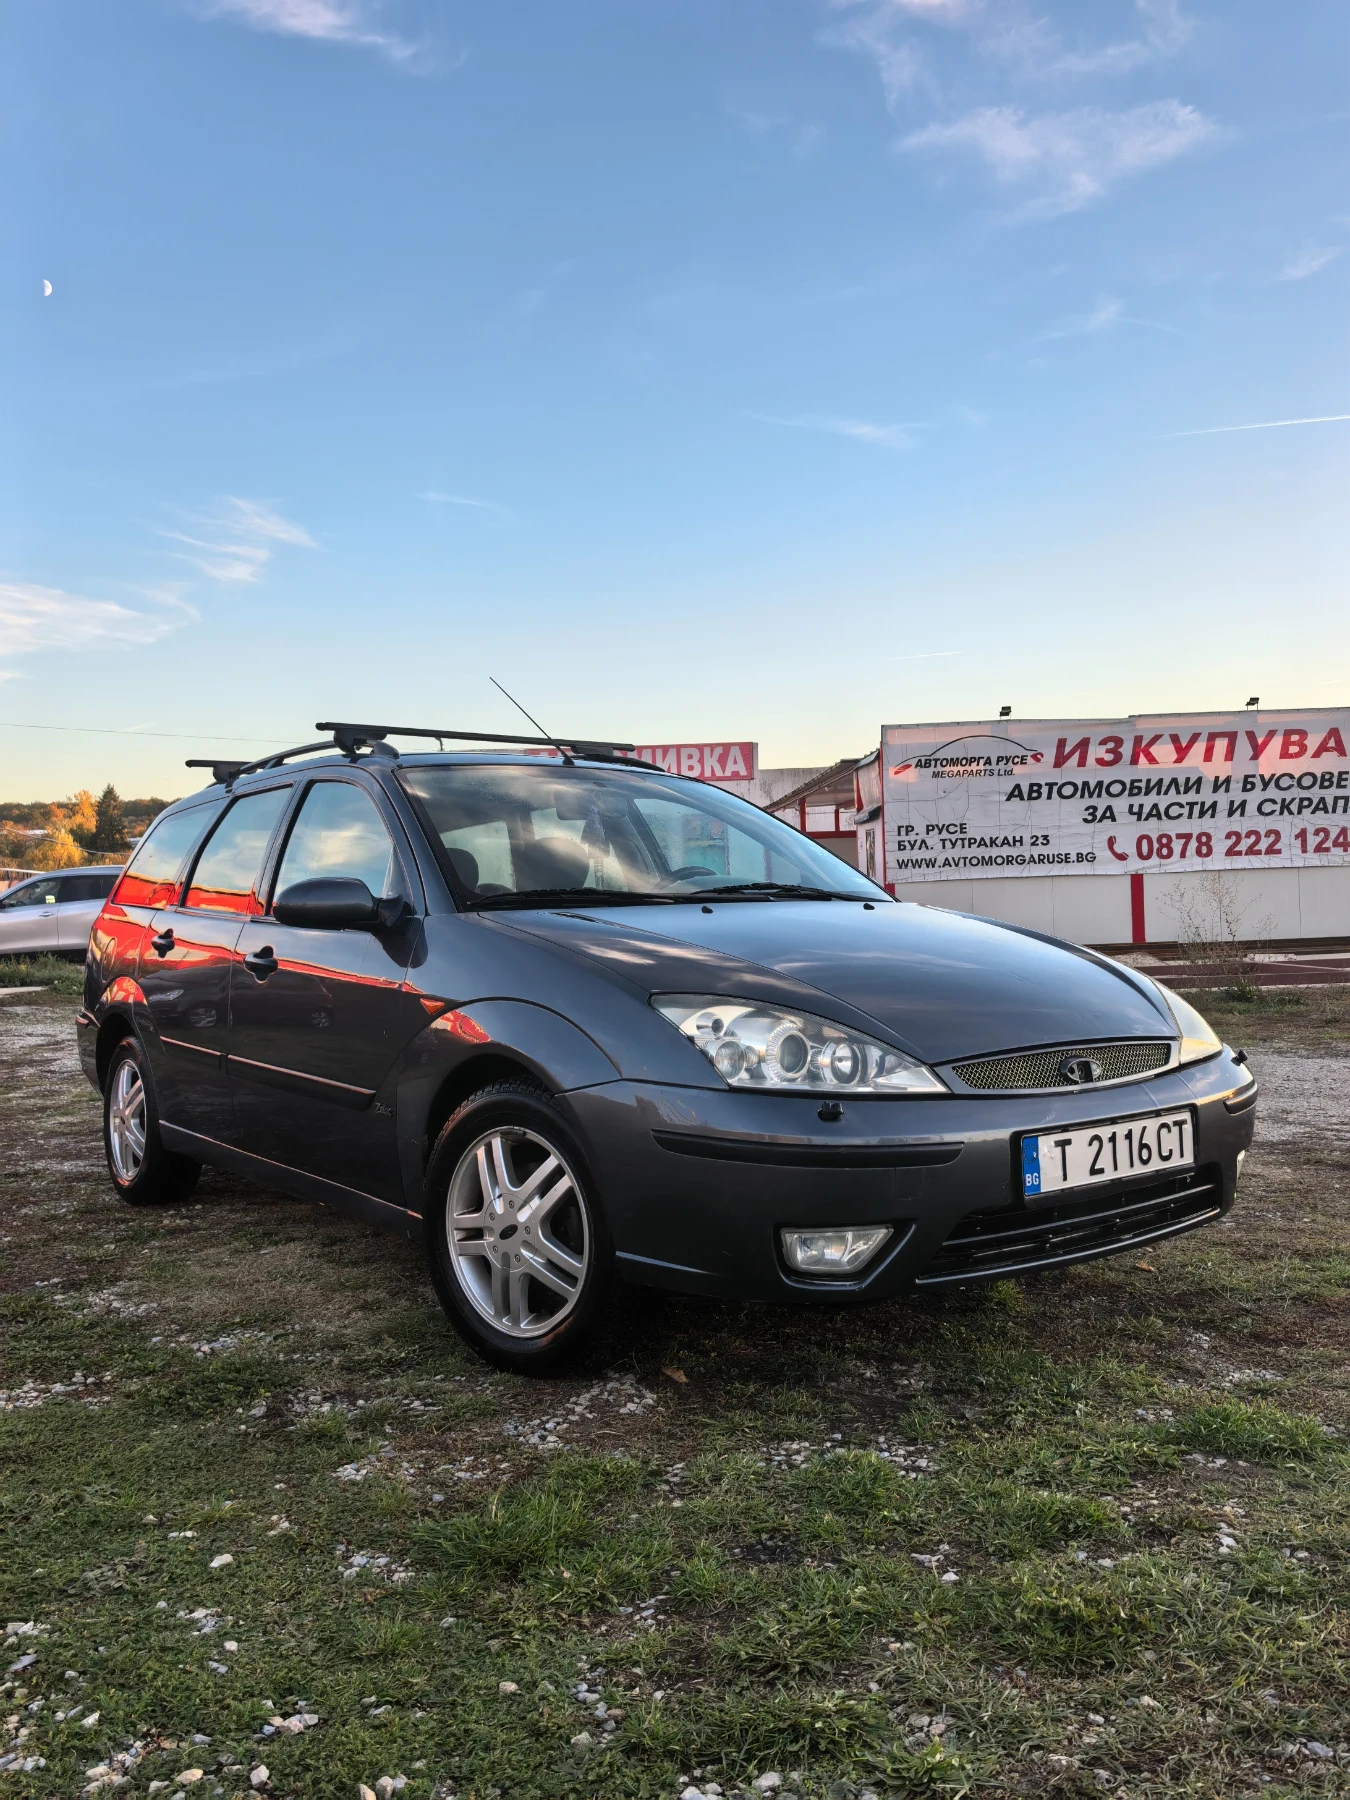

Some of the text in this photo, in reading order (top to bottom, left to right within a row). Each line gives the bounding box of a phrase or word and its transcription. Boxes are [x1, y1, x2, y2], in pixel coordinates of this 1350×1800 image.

[1053, 727, 1347, 769] ИЗКУПУВА
[914, 754, 1028, 769] АВТОМОРГА РУСЕ
[931, 768, 1016, 779] MEGAPARTS Ltd.
[1005, 771, 1350, 801] АВТОМОБИЛИ И БУСОВЕ
[1082, 796, 1350, 824] ЗА ЧАСТИ И СКРАП
[897, 823, 968, 836] ГР. РУСЕ
[897, 835, 1050, 851] БУЛ. ТУТРАКАН 23
[1136, 826, 1350, 861] 0878 222 124
[896, 852, 1097, 870] WWW.AVTOMORGARUSE.BG
[1025, 1172, 1039, 1187] BG
